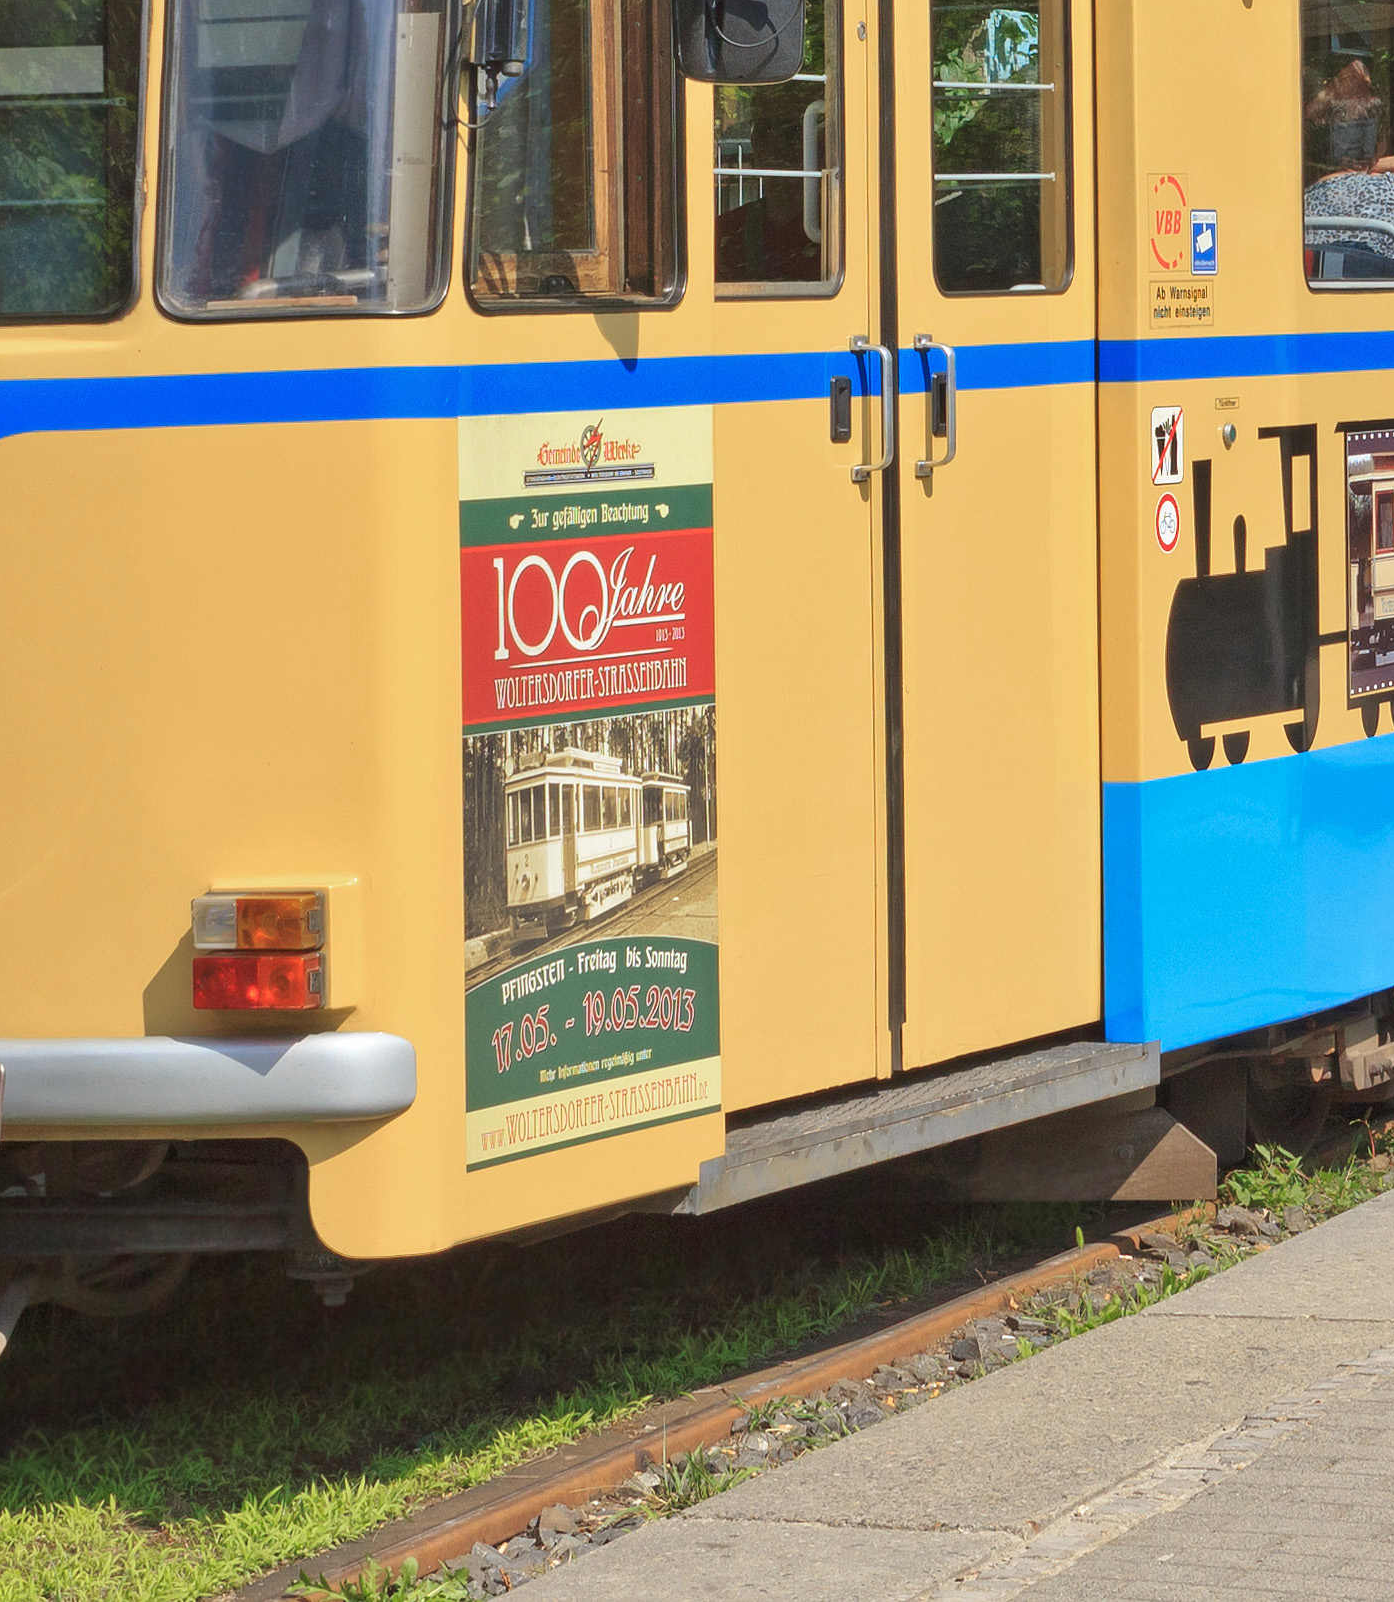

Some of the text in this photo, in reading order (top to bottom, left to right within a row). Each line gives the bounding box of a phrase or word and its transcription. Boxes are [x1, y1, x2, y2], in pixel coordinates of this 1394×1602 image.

[1155, 210, 1182, 235] VBB
[1156, 285, 1208, 303] Ab Warnsignal
[1153, 304, 1211, 321] nicht einsteigen
[530, 502, 649, 531] Zur gefälligen Beachtung
[493, 546, 686, 661] 100 Jahre
[494, 657, 688, 710] WOLTERSDORFER-STRASSENBAHN
[577, 948, 617, 975] Freitag
[625, 946, 642, 968] bis
[645, 946, 688, 975] Sonntag
[491, 1003, 558, 1074] 17.05.
[582, 985, 697, 1037] 19.05.2013
